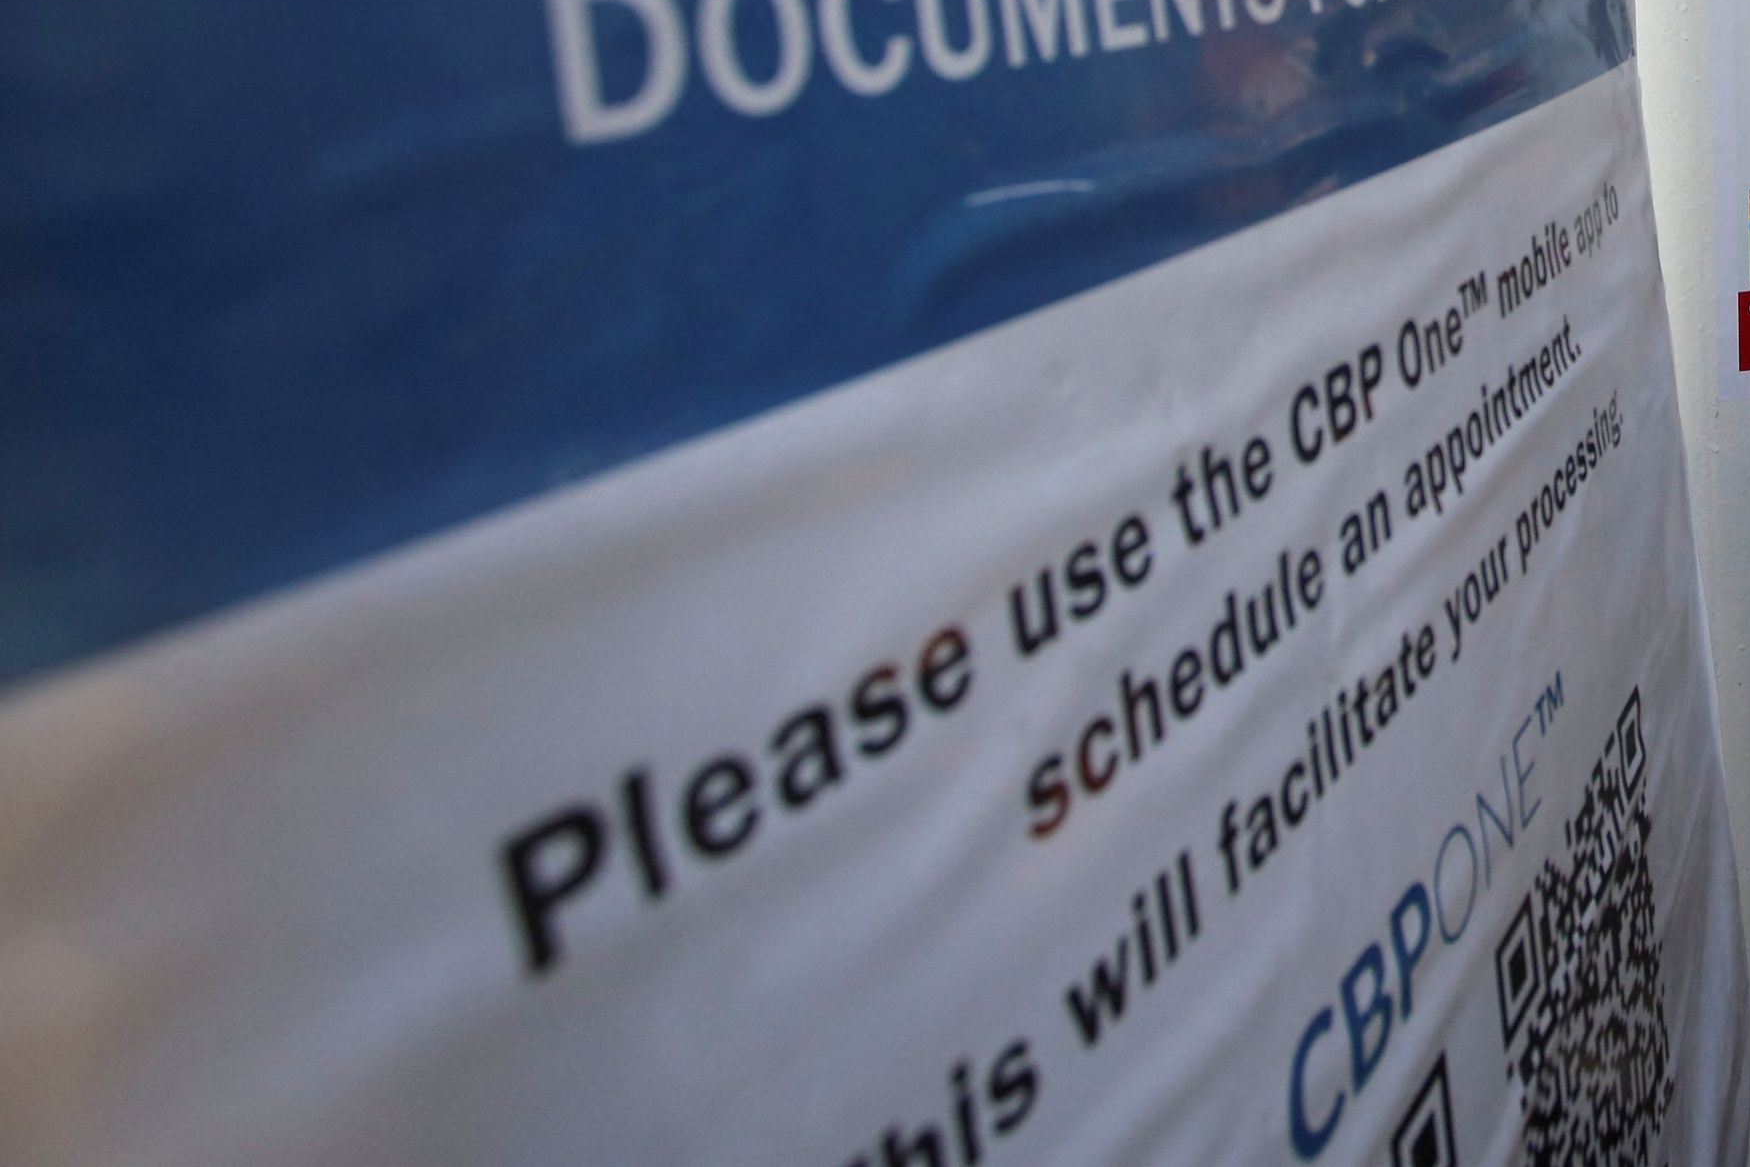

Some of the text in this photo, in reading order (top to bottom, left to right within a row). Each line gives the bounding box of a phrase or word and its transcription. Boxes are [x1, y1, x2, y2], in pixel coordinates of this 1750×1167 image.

[498, 622, 976, 978] Please
[1007, 511, 1153, 661] use
[1169, 440, 1275, 548] the
[1287, 341, 1385, 466] CBP
[1496, 221, 1572, 320] mobile
[1574, 199, 1602, 258] app
[1603, 180, 1619, 226] to
[1022, 313, 1583, 842] schedule an appointment.
[1063, 847, 1203, 1049] will
[1216, 618, 1437, 897] facilitate
[1442, 534, 1514, 662] your
[1514, 387, 1624, 576] processing.
